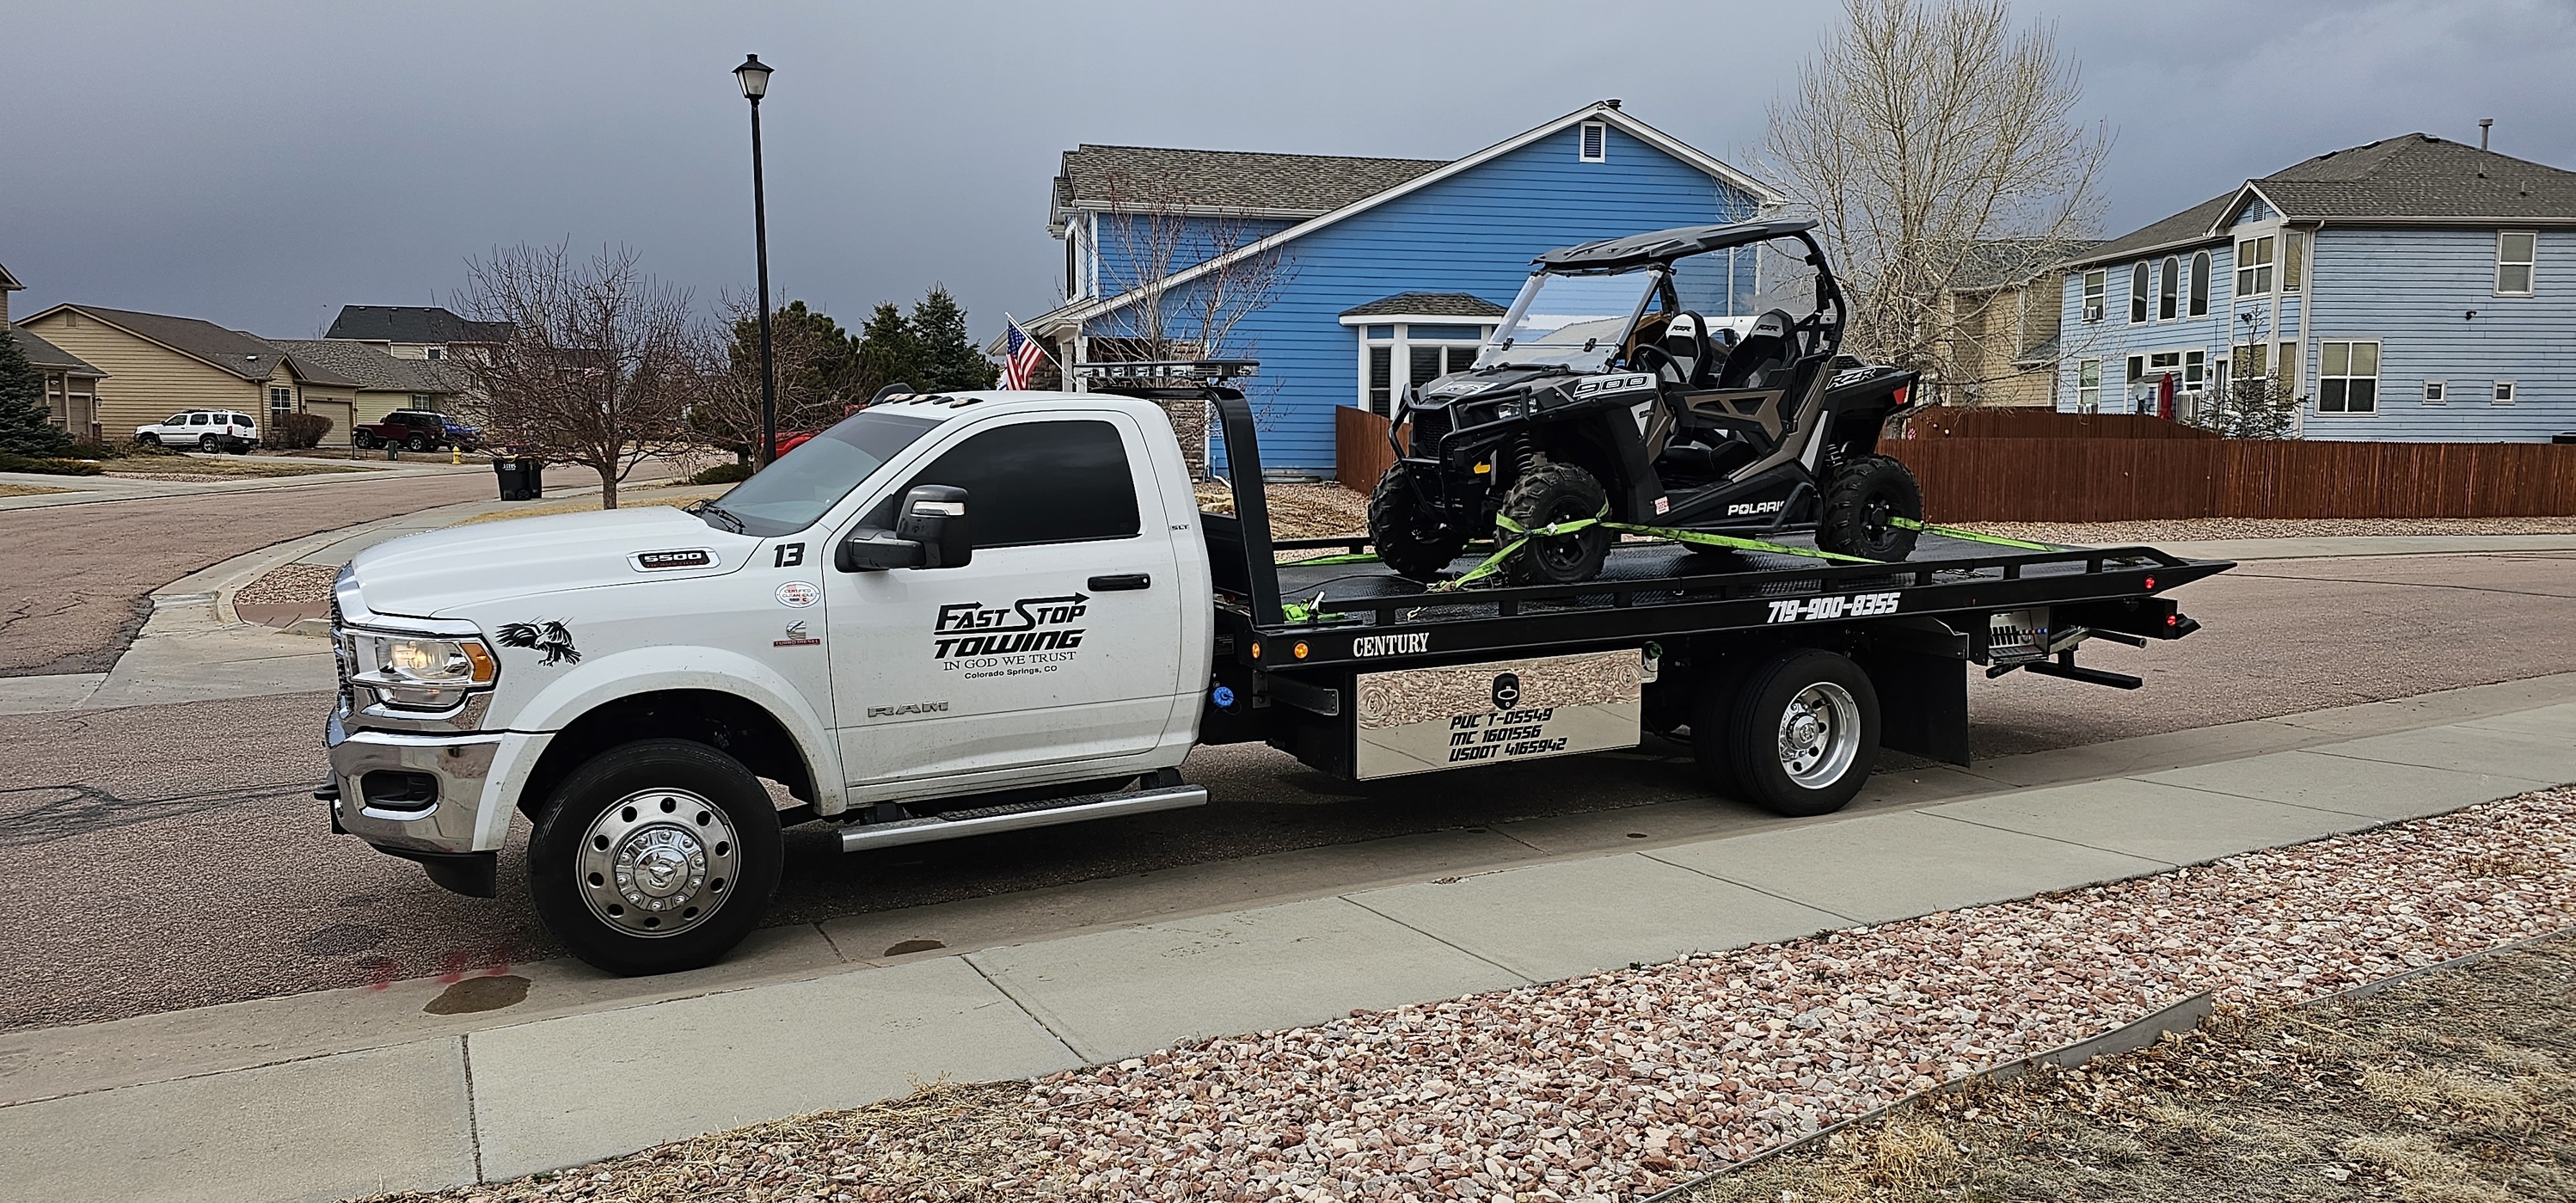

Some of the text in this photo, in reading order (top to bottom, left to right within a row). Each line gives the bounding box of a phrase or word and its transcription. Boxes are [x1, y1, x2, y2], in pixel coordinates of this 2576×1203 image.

[1671, 324, 1692, 333] RZR
[1756, 323, 1779, 333] RZR
[1573, 375, 1649, 397] 900
[1825, 368, 1876, 390] RZR
[645, 553, 702, 562] 5500
[773, 542, 806, 568] 13
[935, 596, 1087, 631] FAST STOP
[1767, 592, 1901, 623] 719-900-8355
[934, 629, 1087, 660] TOWING
[1353, 632, 1430, 657] CENTURY
[943, 651, 1076, 671] IN GOD WE TRUST
[964, 670, 1004, 679] Colorado
[1007, 667, 1042, 676] Springs,
[868, 700, 948, 717] RAM
[1450, 707, 1554, 730] PUC T-05549
[1450, 724, 1543, 746] MC 1601556
[1449, 737, 1567, 762] USDOT 4165942
